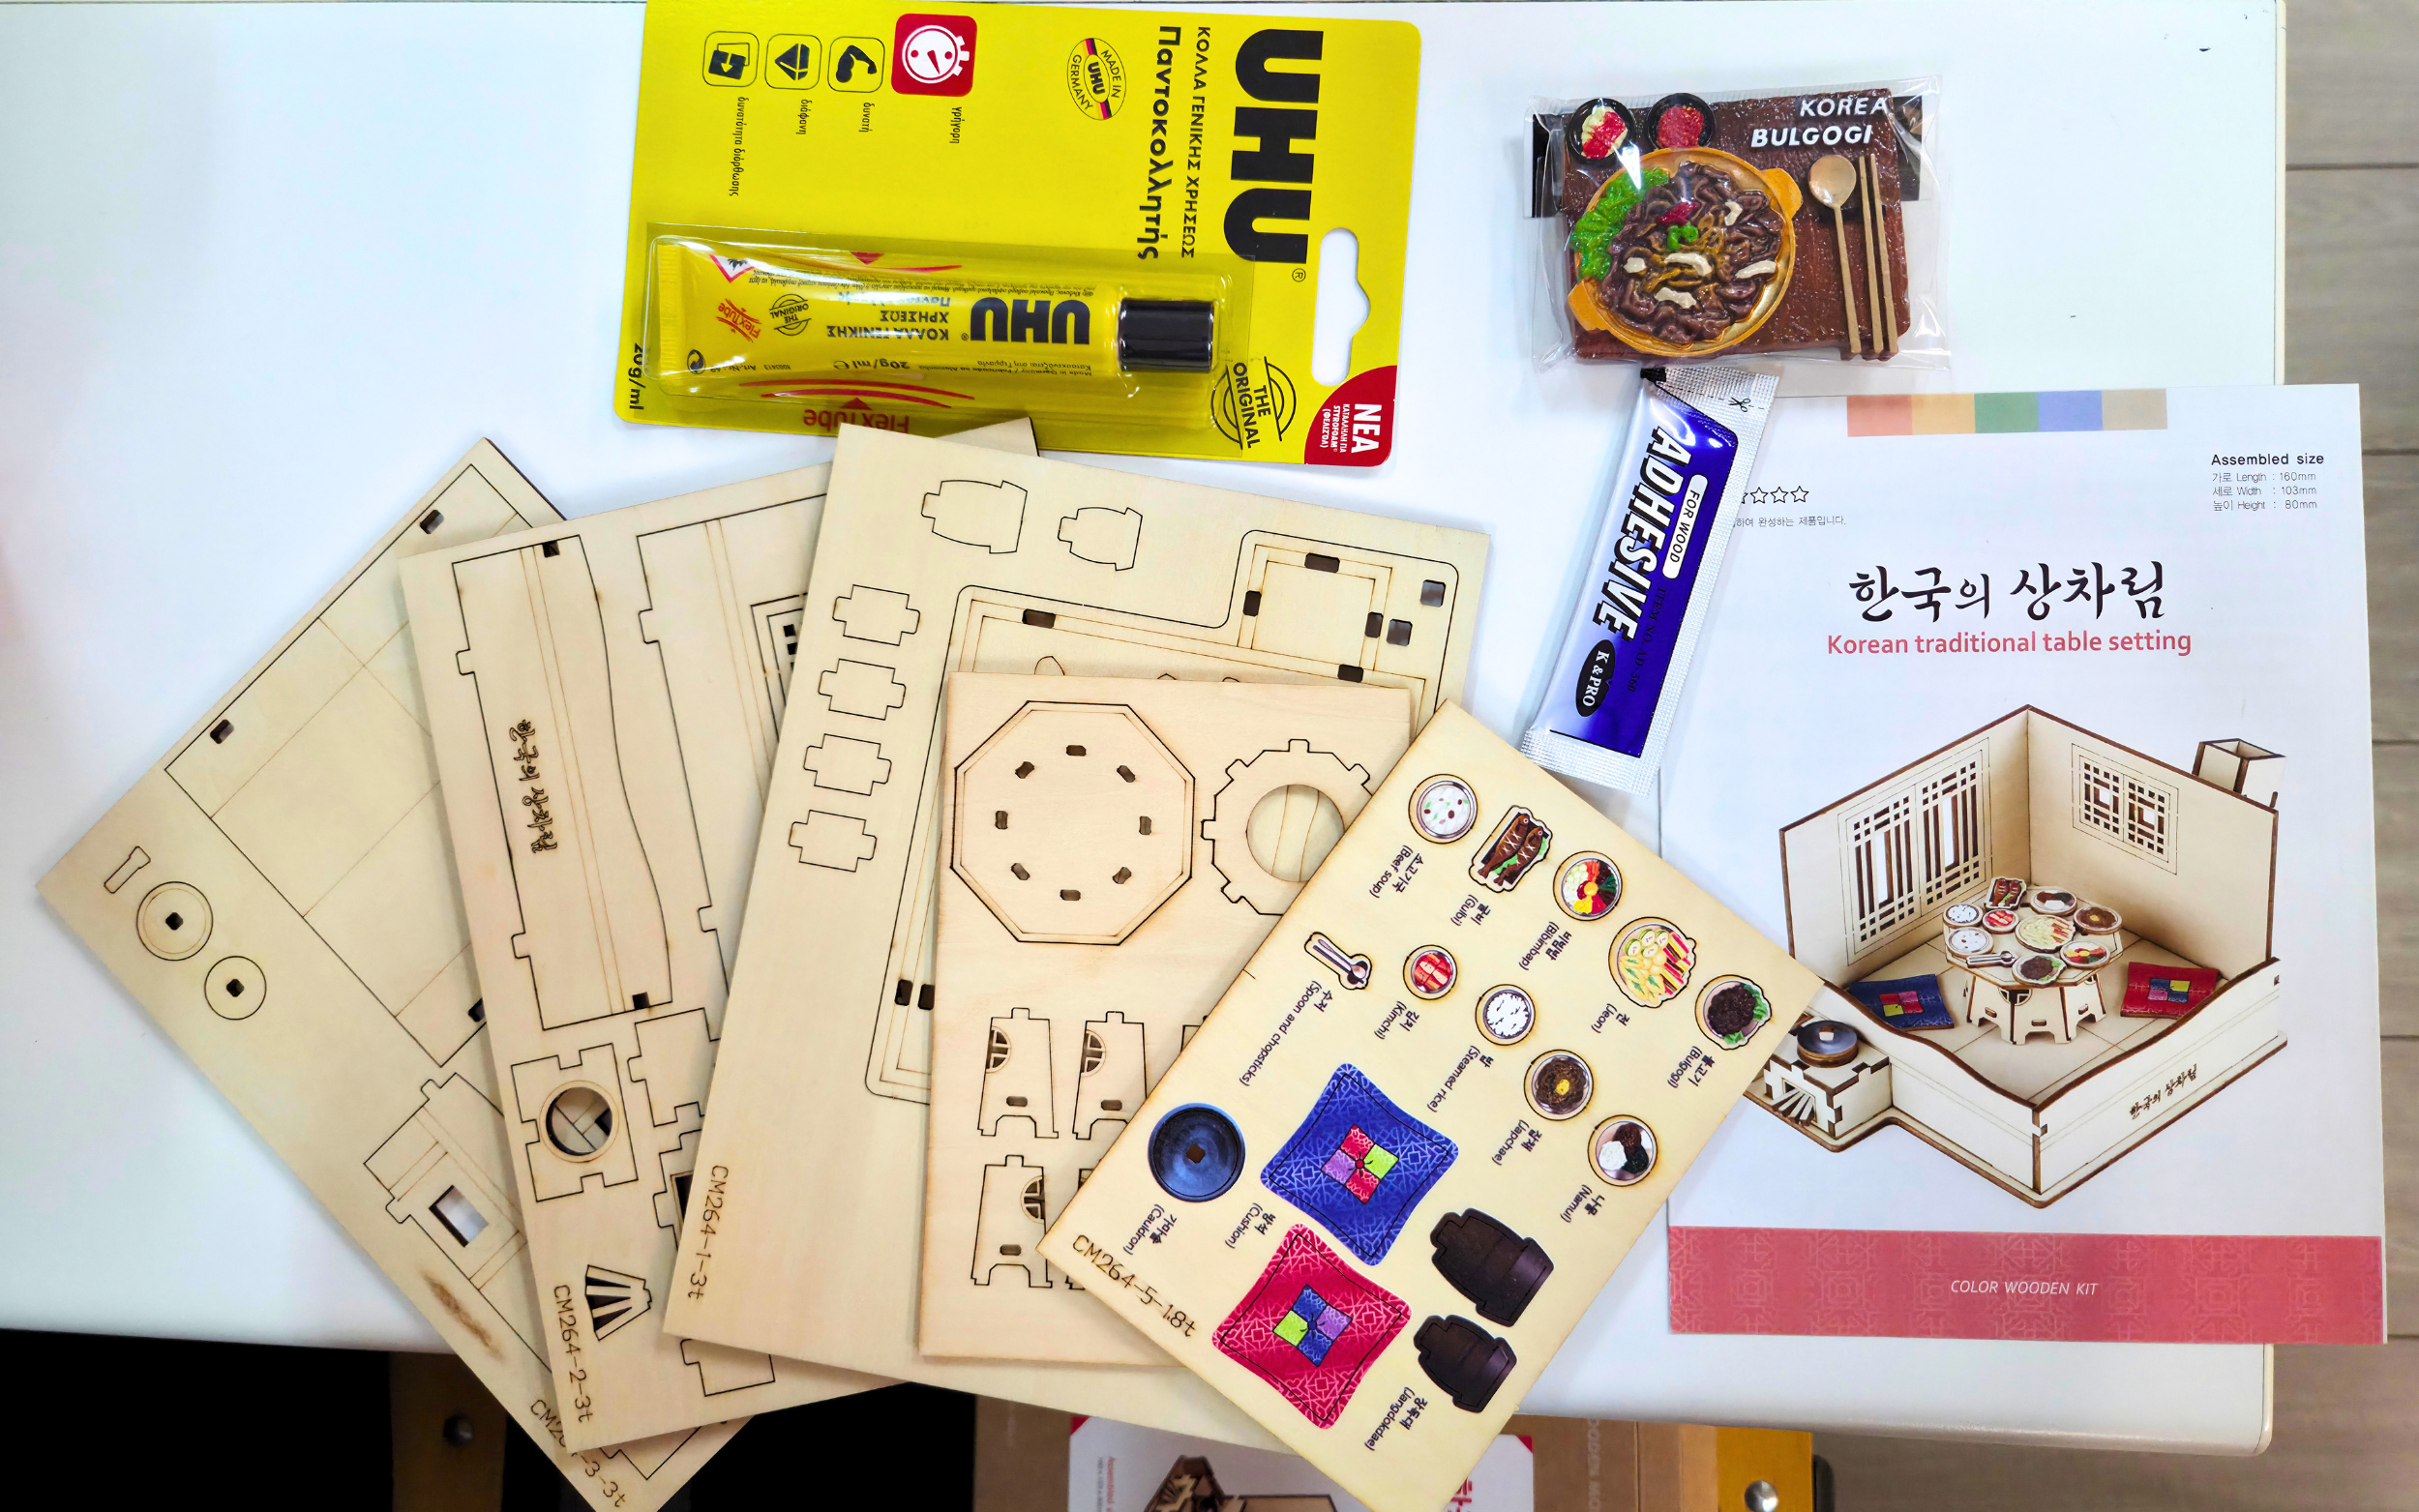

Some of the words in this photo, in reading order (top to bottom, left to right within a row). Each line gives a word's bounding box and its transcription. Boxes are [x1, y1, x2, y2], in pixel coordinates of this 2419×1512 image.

[1101, 49, 1121, 81] MADE
[1111, 85, 1121, 98] IN
[1193, 27, 1210, 90] ΚΟΛΛΑ
[1071, 54, 1093, 109] GERMANY
[1088, 62, 1105, 95] UHU
[733, 96, 749, 145] δυνατότητα
[795, 99, 813, 135] διάφανη
[858, 102, 875, 133] δυνατή
[1799, 96, 1889, 118] KOREA
[949, 106, 965, 144] γρήγορη
[1187, 96, 1205, 171] ΓΕΝΙΚΗΣ
[1750, 125, 1872, 148] BULGOGI
[1138, 26, 1181, 260] Παντοκολλητής
[1223, 29, 1324, 264] UHU
[729, 148, 746, 197] διόρθωσης
[1181, 176, 1200, 258] ΧΡΗΣΕΩΣ
[769, 303, 810, 320] ORIGINAL
[784, 314, 799, 324] THE
[879, 311, 950, 324] ΧΡΗΣΕΩΣ
[970, 297, 1090, 345] UHU
[1233, 364, 1261, 449] ORIGINAL
[1253, 385, 1271, 417] THE
[2211, 454, 2288, 465] Assembled
[2296, 453, 2324, 464] size
[2212, 472, 2232, 483] 가로
[2236, 472, 2267, 483] Length
[2280, 472, 2316, 481] 160mm
[2213, 487, 2232, 497] 세로
[2237, 487, 2261, 495] Width
[2282, 487, 2316, 495] 103mm
[1681, 489, 1701, 519] FOR
[2213, 500, 2233, 512] 높이
[2238, 500, 2266, 511] Height
[2285, 500, 2317, 509] 80mm
[1593, 426, 1691, 643] ADHESIVE
[1733, 518, 1753, 527] 하여
[1758, 517, 1794, 527] 완성하는
[1799, 516, 1846, 525] 제품입니다.
[1669, 520, 1693, 564] WOOD
[1848, 564, 1991, 623] 한국의
[2010, 561, 2166, 621] 상차림
[1827, 633, 1909, 657] Korean
[1914, 632, 2037, 655] traditional
[2043, 631, 2103, 654] table
[2108, 630, 2193, 657] setting
[1582, 675, 1601, 706] PRO
[1389, 845, 1414, 873] (Beef
[1394, 853, 1424, 894] 소고기국
[1369, 870, 1392, 898] soup)
[1450, 894, 1478, 927] (Gulbi)
[1475, 904, 1491, 926] 굴비
[1519, 921, 1560, 971] (Bibimbap)
[1546, 931, 1572, 961] 비빔밥
[1293, 981, 1323, 1016] (Spoon
[1314, 989, 1333, 1013] 수저
[1277, 1013, 1296, 1034] and
[1374, 1000, 1407, 1040] (Kimchi)
[1399, 1010, 1420, 1032] 김치
[1591, 1003, 1616, 1034] (Jeon)
[1617, 1013, 1630, 1027] 전
[1239, 1031, 1282, 1086] chopsticks)
[1445, 1045, 1480, 1090] (Steamed
[1479, 1054, 1494, 1068] 밥
[1667, 1046, 1702, 1089] (Bulgogi)
[1693, 1055, 1716, 1087] 불고기
[1427, 1088, 1447, 1112] rice)
[1491, 1119, 1531, 1167] (Japchae)
[1521, 1128, 1542, 1153] 잡채
[1560, 1183, 1592, 1224] (Namul)
[1584, 1195, 1605, 1217] 나물
[687, 1165, 729, 1301] CM264-1-3t
[1122, 1203, 1165, 1256] (Cauldron)
[1224, 1202, 1264, 1249] (Cushion)
[1254, 1213, 1276, 1236] 방석
[1951, 1280, 1998, 1293] COLOR
[2005, 1282, 2070, 1294] WOODEN
[2076, 1283, 2099, 1295] KIT
[553, 1284, 594, 1423] CM264-2-3t
[1364, 1386, 1415, 1451] (Jangdokdae)
[1399, 1397, 1429, 1431] 장독대
[529, 1399, 626, 1508] CM2-3-3t
